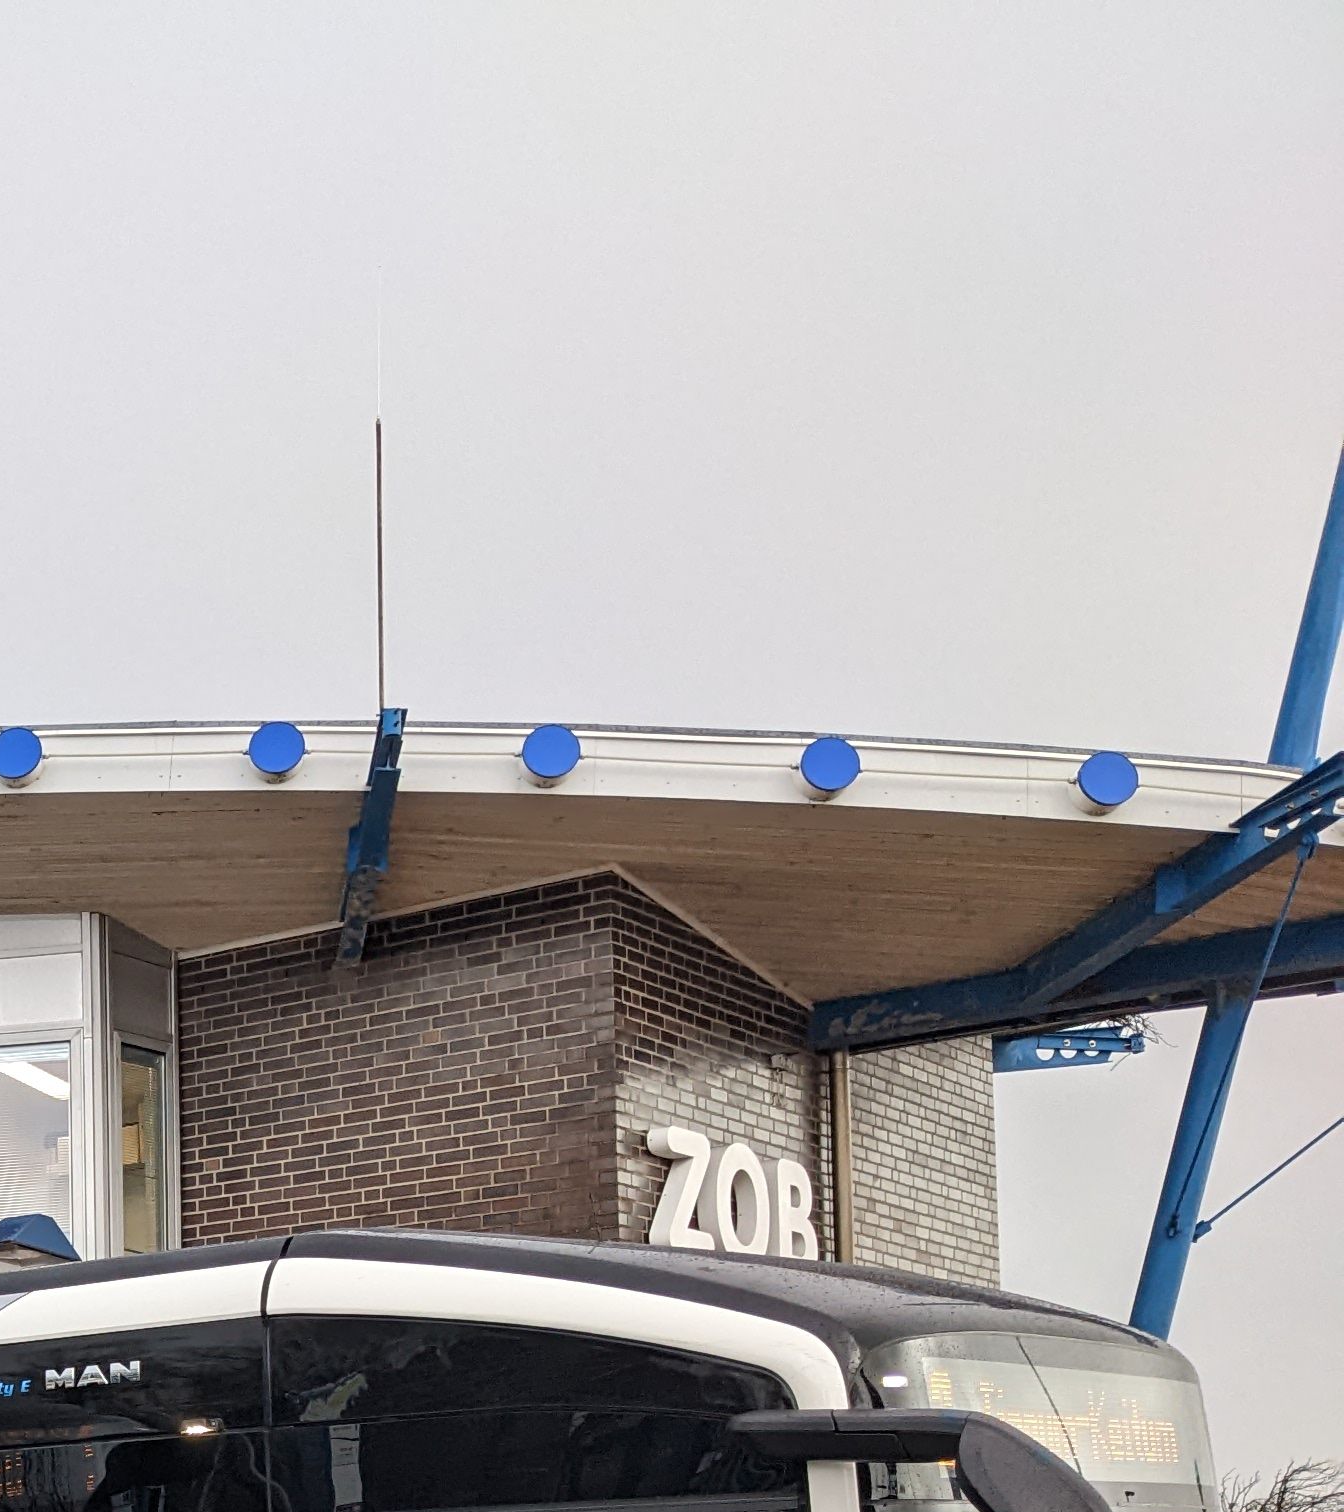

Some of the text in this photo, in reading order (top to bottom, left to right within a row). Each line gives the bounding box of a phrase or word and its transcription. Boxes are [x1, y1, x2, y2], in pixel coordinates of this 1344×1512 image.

[647, 1125, 818, 1261] ZOB
[21, 1379, 32, 1393] E
[45, 1360, 141, 1391] MAN
